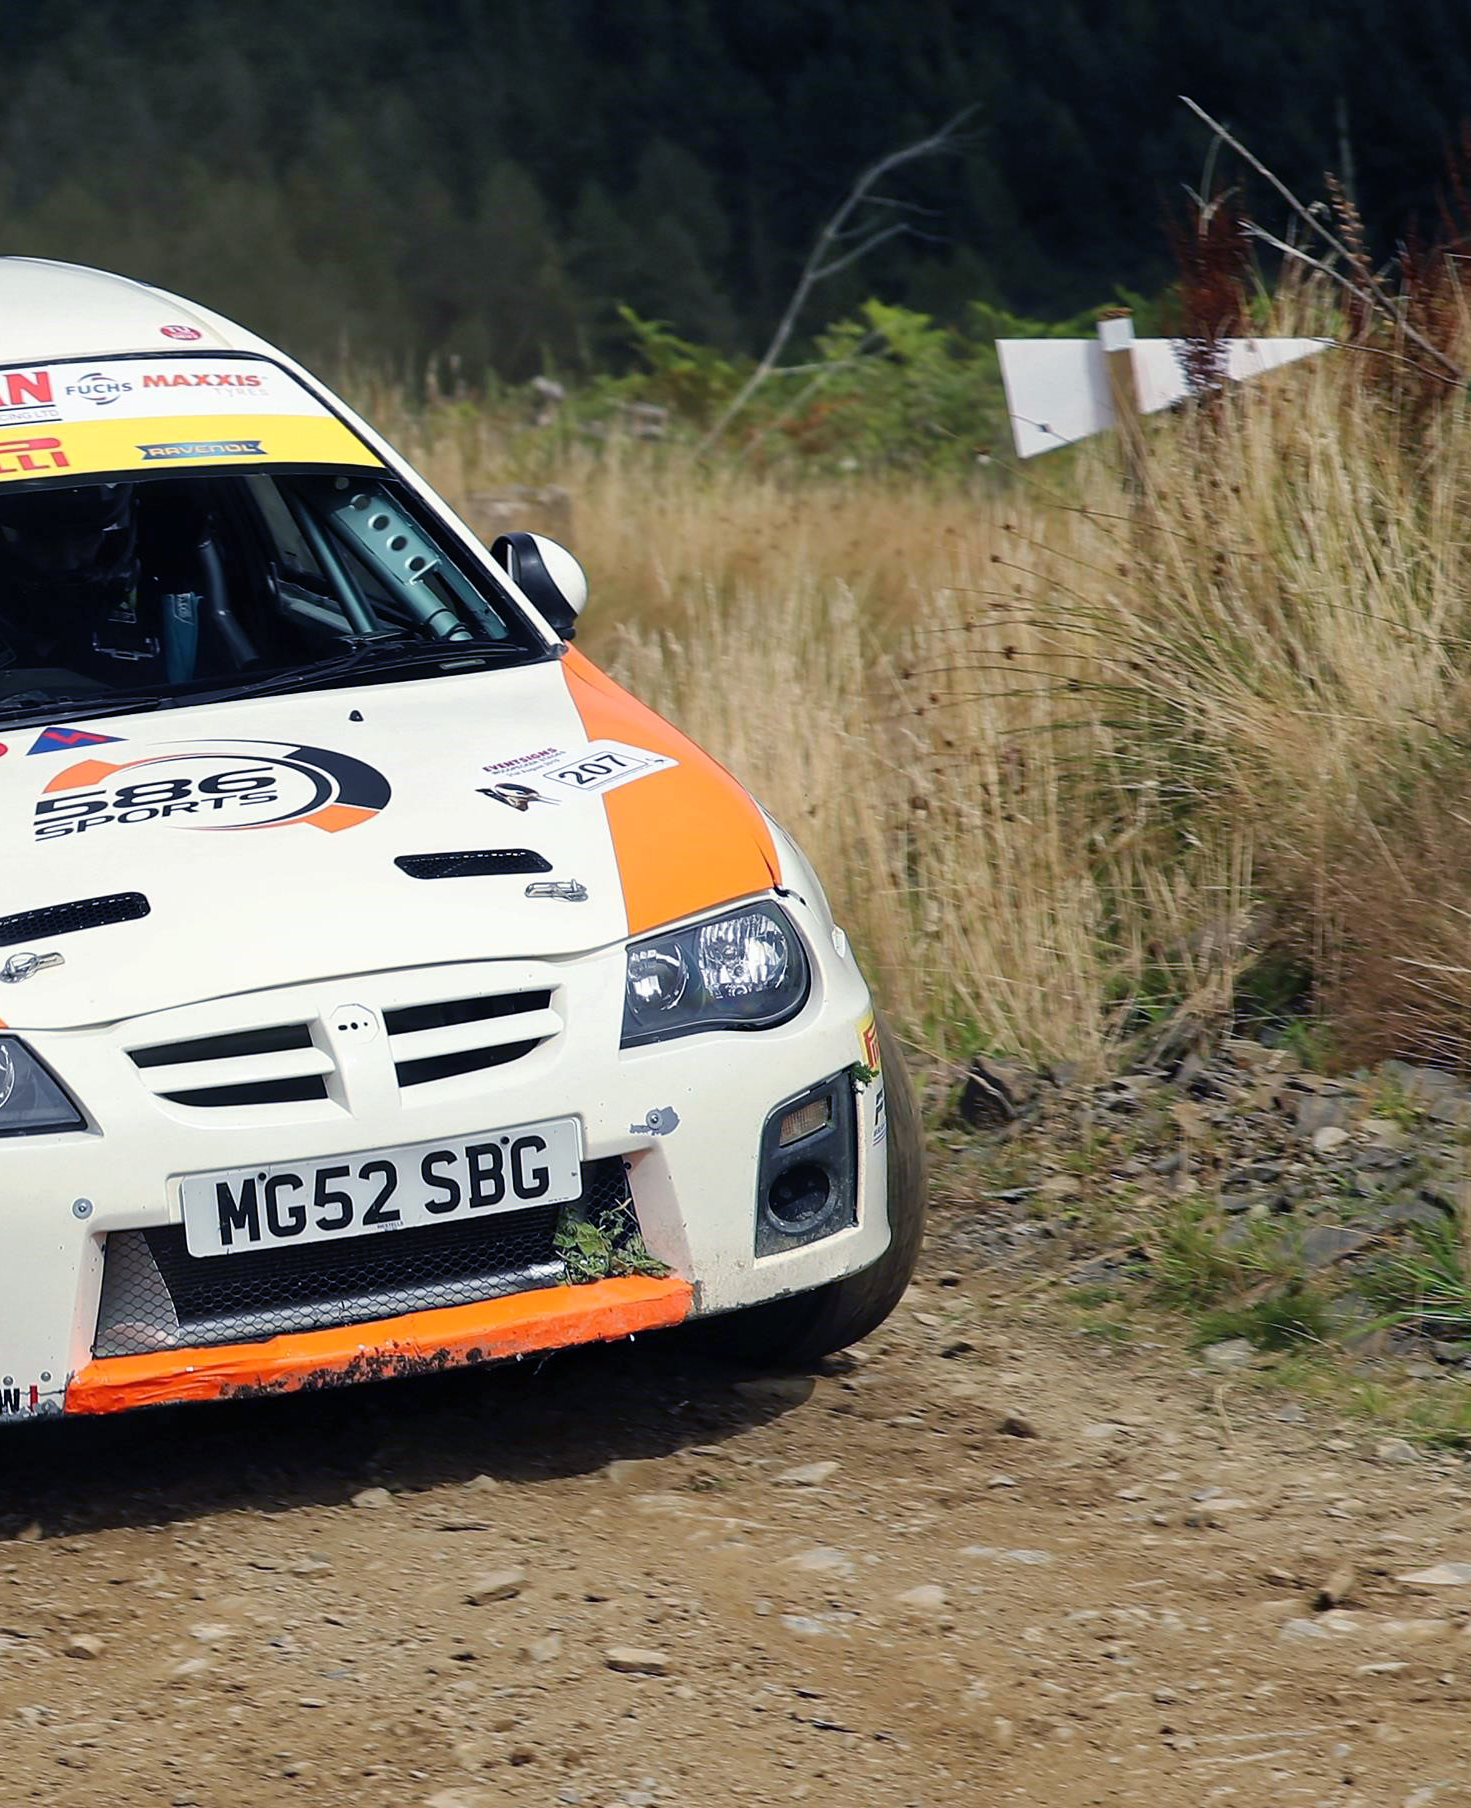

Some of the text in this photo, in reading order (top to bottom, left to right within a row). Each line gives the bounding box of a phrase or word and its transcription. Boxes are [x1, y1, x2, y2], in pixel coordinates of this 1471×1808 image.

[66, 380, 133, 396] FUCHS
[143, 373, 262, 388] MAXXIS
[215, 387, 269, 397] TYRES
[146, 444, 256, 458] RAVENOL
[482, 747, 558, 773] EVENTSIGNS
[558, 754, 627, 785] 207
[34, 767, 278, 826] 586
[35, 789, 279, 842] SPORTS
[215, 1135, 550, 1245] MG52 SBG
